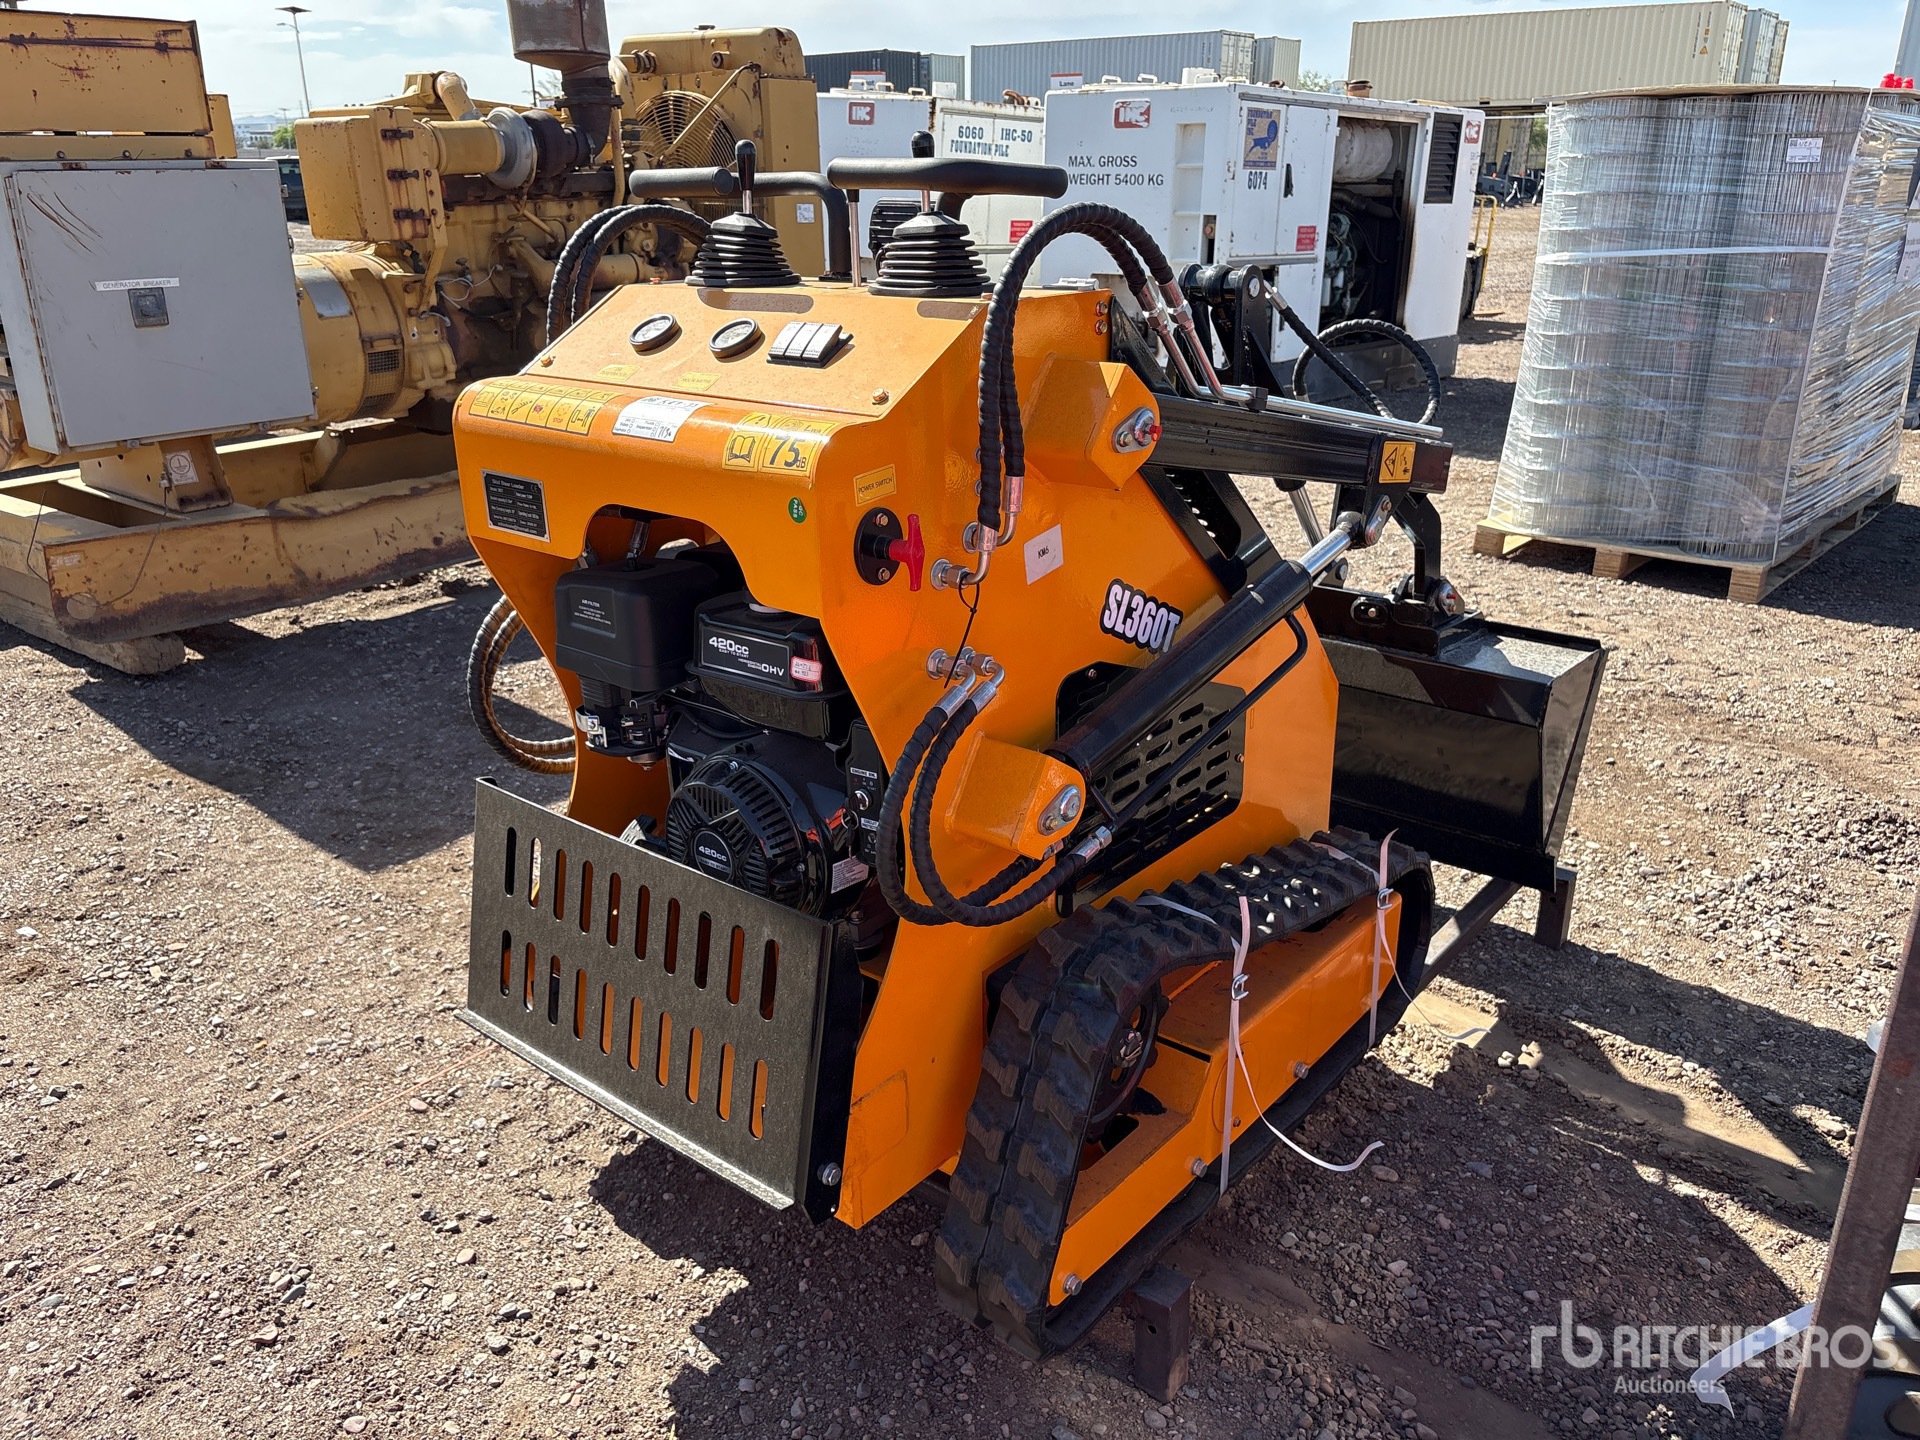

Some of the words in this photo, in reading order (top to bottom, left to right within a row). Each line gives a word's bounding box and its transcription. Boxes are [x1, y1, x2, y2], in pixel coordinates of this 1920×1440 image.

[958, 125, 984, 140] 6060
[1001, 127, 1033, 143] IHC-50
[950, 139, 992, 156] FOUNDATION
[994, 143, 1010, 158] PILE
[1068, 155, 1096, 168] MAX.
[1098, 155, 1138, 168] GROSS
[1067, 173, 1111, 186] WEIGHT
[1114, 173, 1145, 186] 5400
[1148, 173, 1164, 186] KG
[1247, 171, 1268, 190] 6074
[103, 281, 141, 290] GENERATOR
[143, 279, 172, 287] BREAKER
[769, 434, 805, 468] 75
[858, 482, 875, 494] POWER
[875, 476, 893, 488] SWITCH
[1103, 583, 1181, 653] SL360T
[708, 636, 750, 655] 420cc
[761, 663, 785, 677] OHV
[698, 845, 727, 862] 420cc
